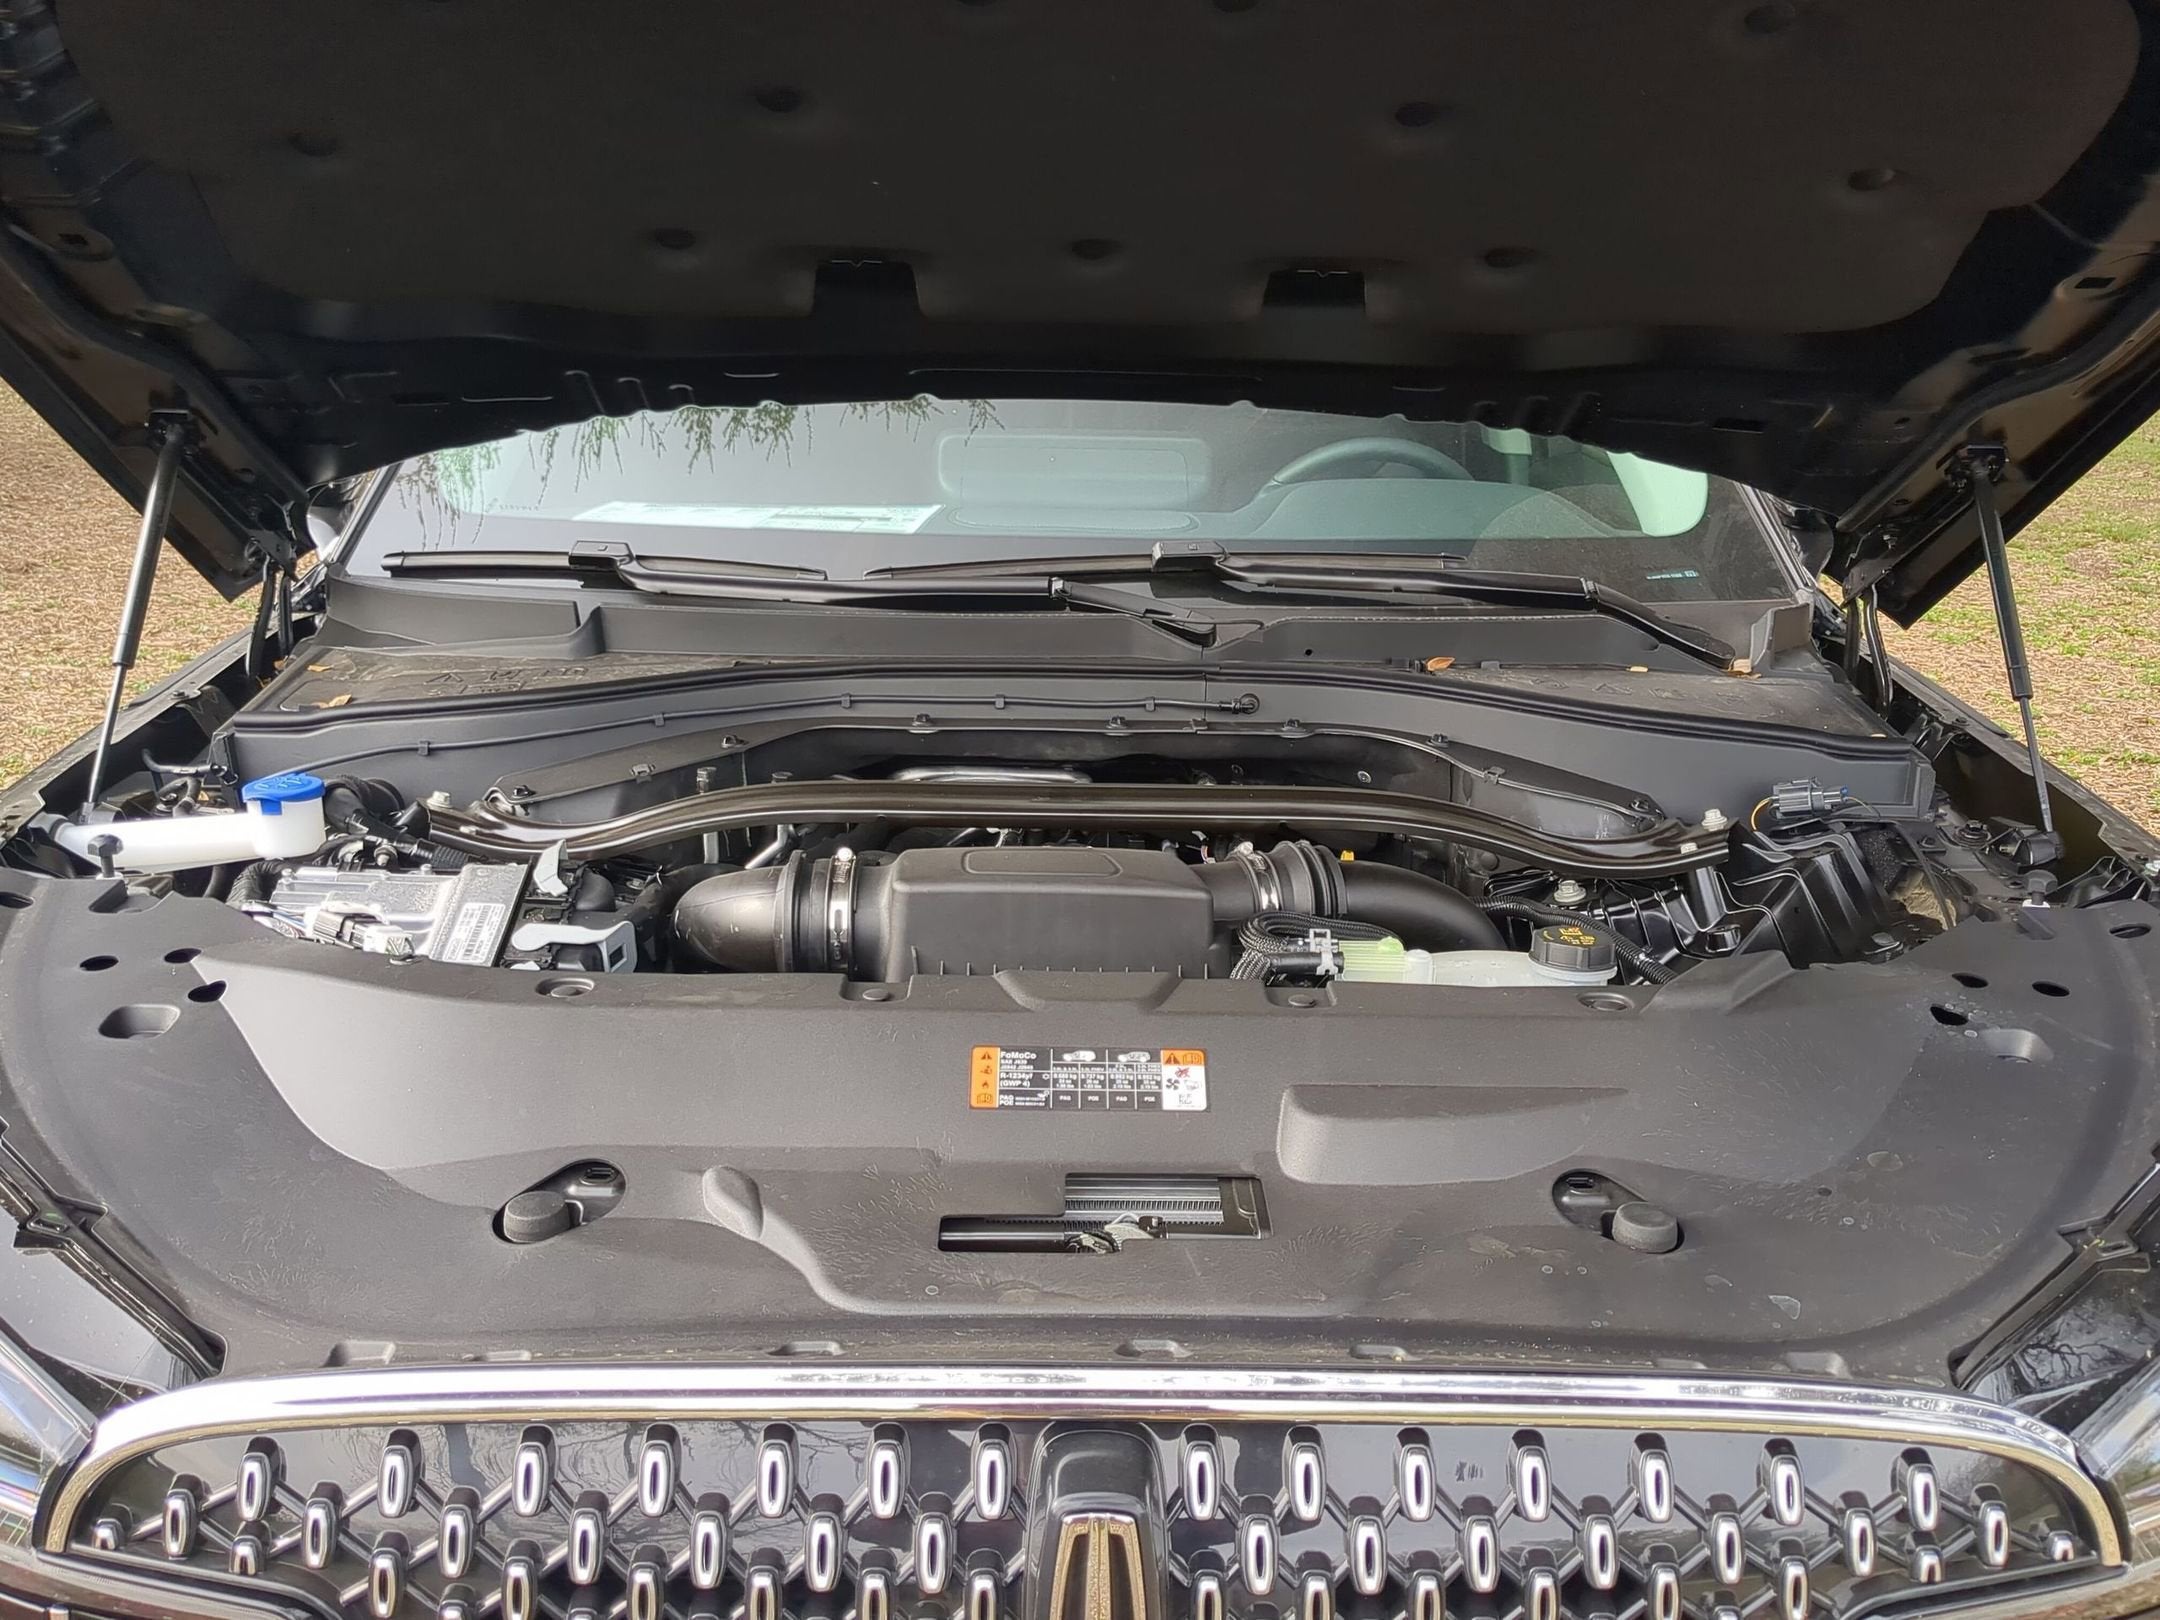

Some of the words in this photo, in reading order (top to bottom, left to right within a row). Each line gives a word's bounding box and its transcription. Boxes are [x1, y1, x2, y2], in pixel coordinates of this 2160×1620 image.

[1000, 1051, 1037, 1060] FoMoCo
[1000, 1072, 1033, 1080] R-1234yf
[1022, 1080, 1030, 1088] 4)
